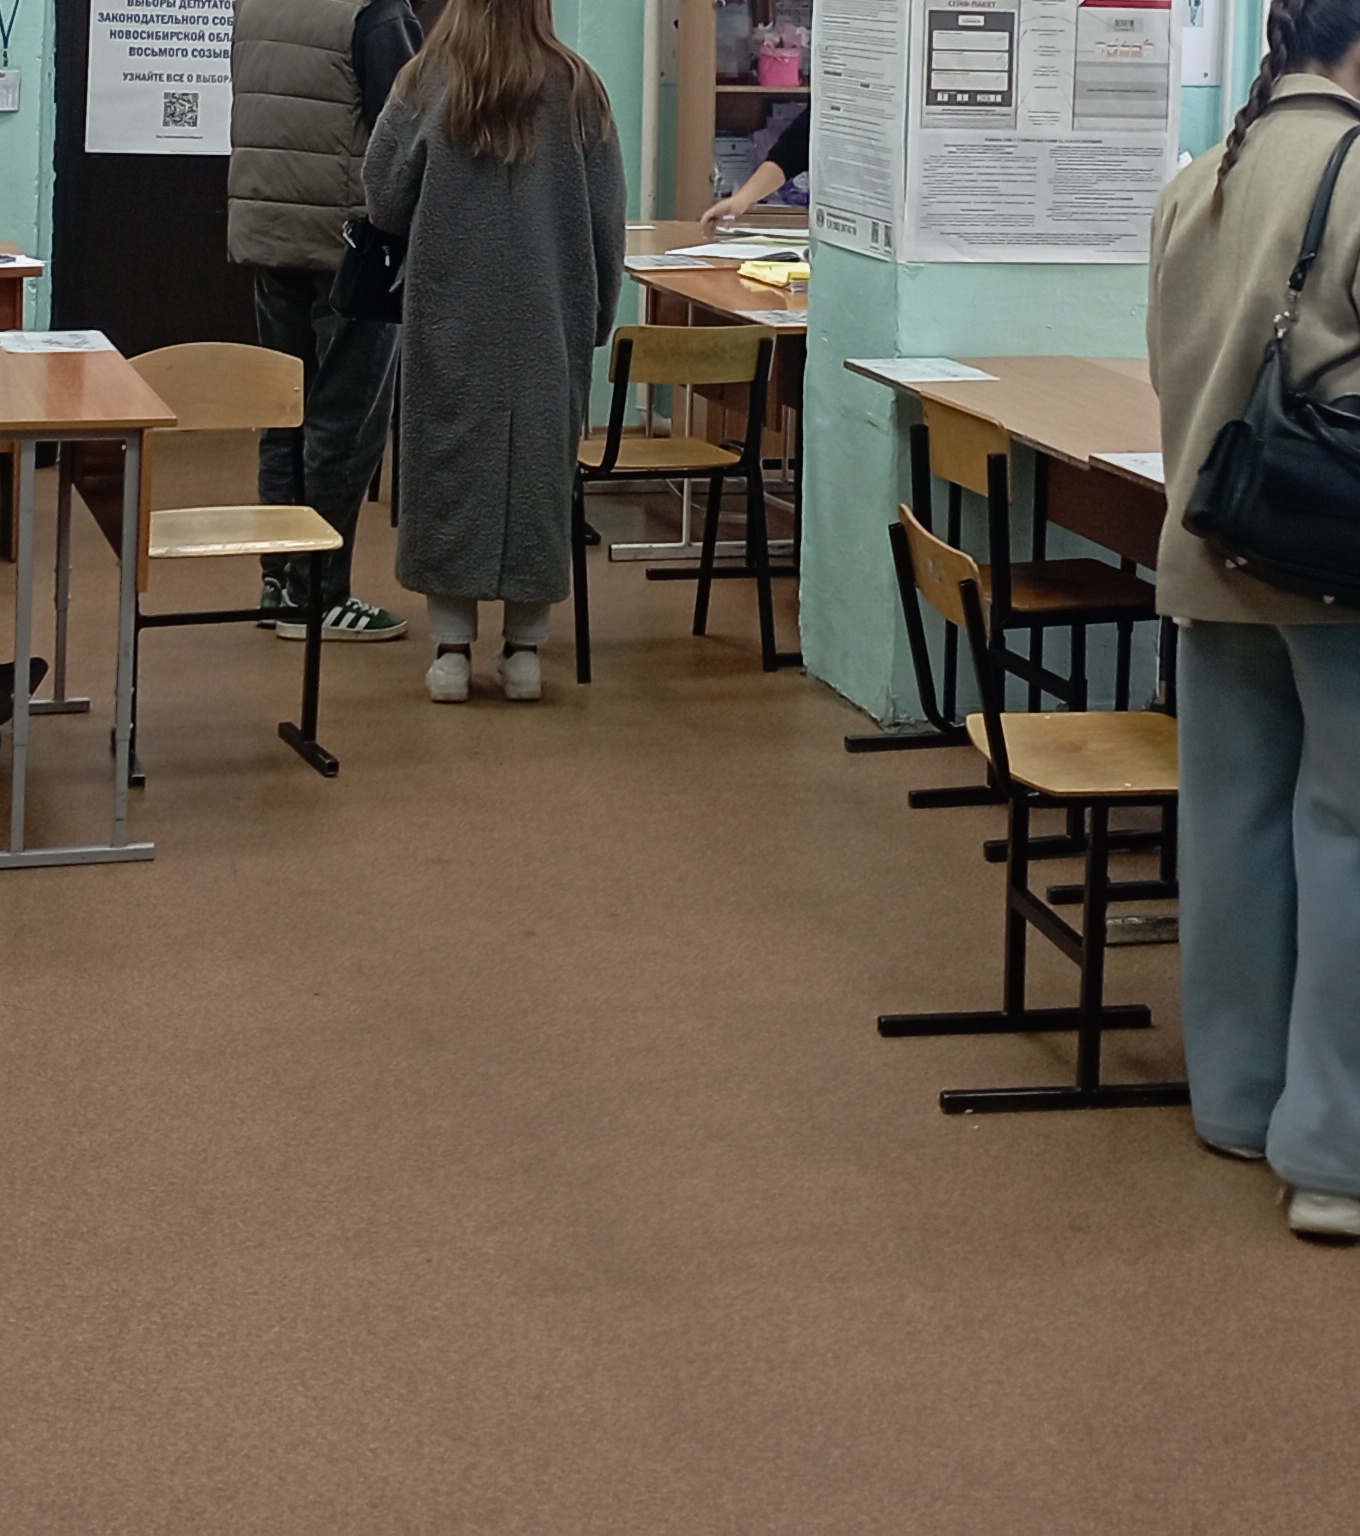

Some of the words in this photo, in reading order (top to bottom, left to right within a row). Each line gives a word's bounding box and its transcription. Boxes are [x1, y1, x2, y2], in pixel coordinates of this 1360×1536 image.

[97, 12, 209, 26] ЗАКОНОДАТЕЛЬНОГО
[109, 29, 205, 42] НОВОСИБИРСКОЙ
[128, 46, 188, 58] ВОСЬМОГО
[191, 49, 232, 59] СОЗЫВ
[122, 71, 165, 82] УЗНАЙТЕ
[166, 72, 185, 83] ВСЕ
[187, 73, 193, 83] О
